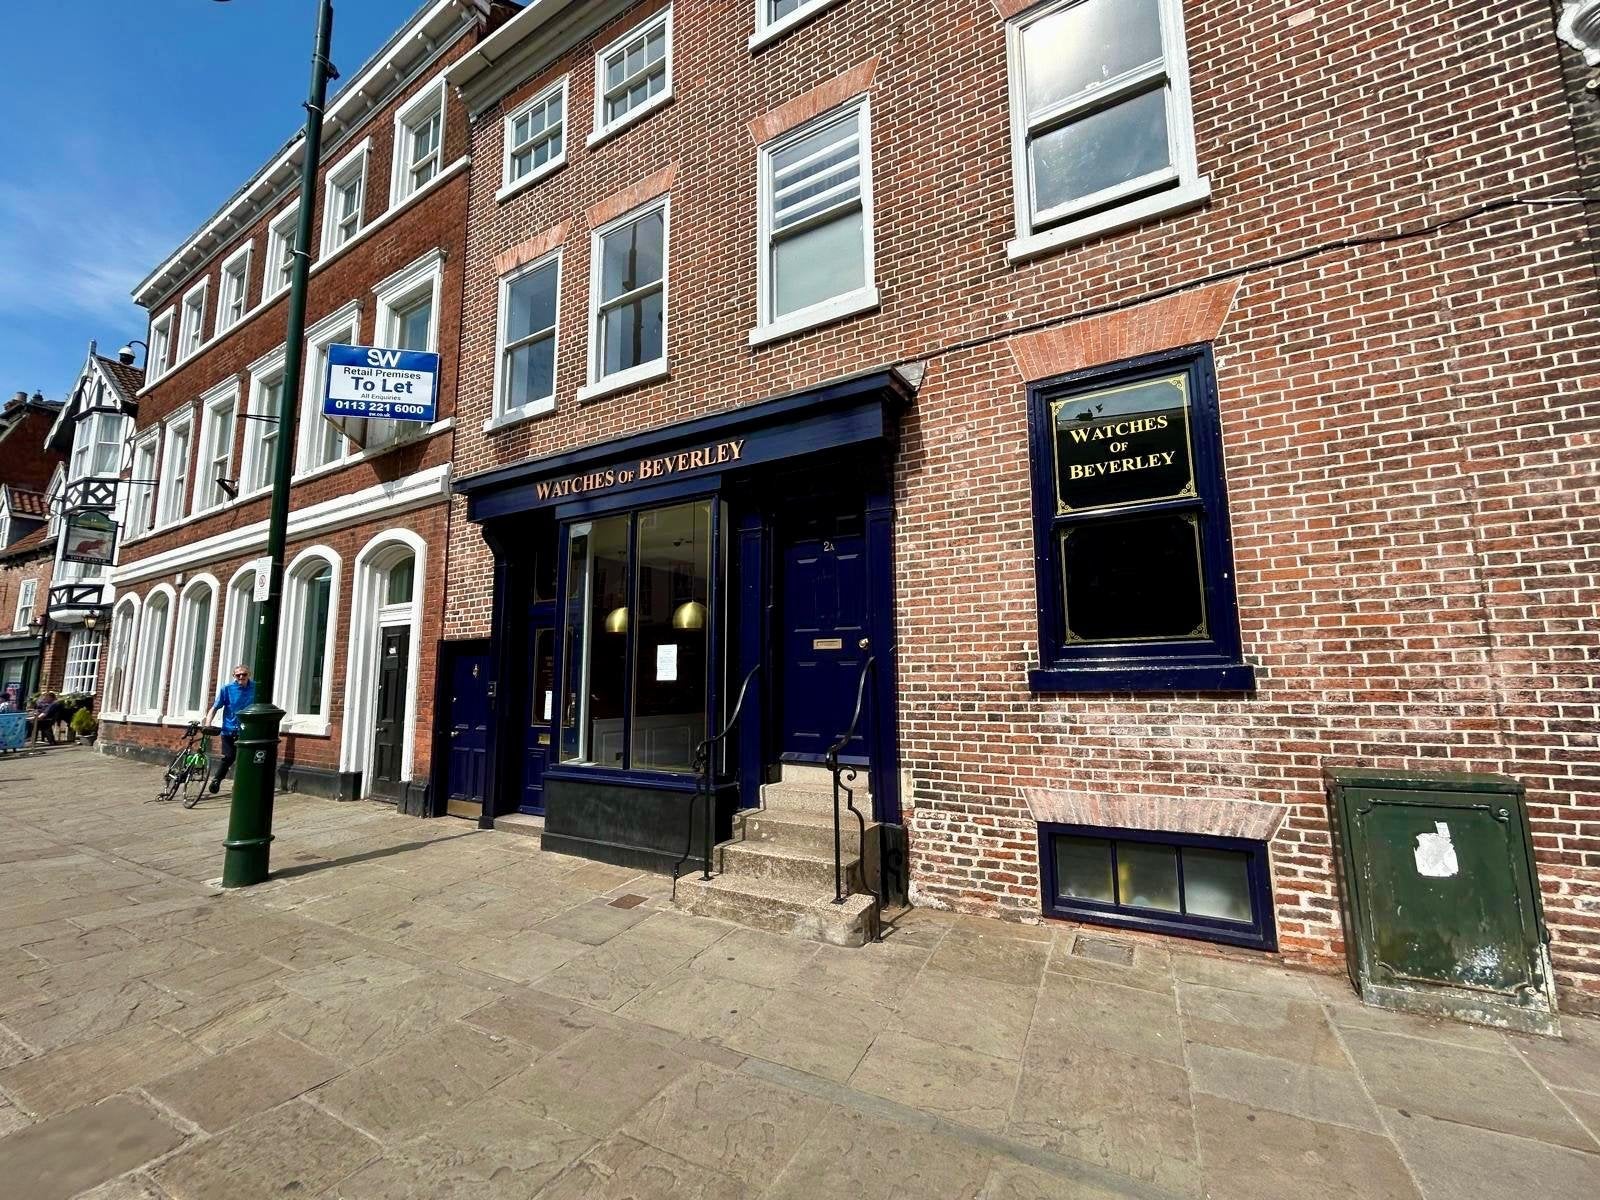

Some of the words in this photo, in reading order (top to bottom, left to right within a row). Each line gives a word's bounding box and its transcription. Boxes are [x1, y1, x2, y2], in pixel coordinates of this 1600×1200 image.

[367, 349, 401, 367] SW
[343, 366, 373, 377] Retail
[375, 369, 421, 380] Premises
[350, 376, 375, 392] To
[381, 378, 413, 394] Let
[371, 394, 402, 402] Enquiries
[335, 400, 366, 410] 0113
[368, 402, 390, 412] 221
[394, 404, 424, 415] 6000
[1070, 415, 1168, 444] WATCHES
[1109, 441, 1129, 454] OF
[535, 469, 614, 501] WATCHES
[618, 470, 635, 484] OF
[639, 440, 744, 479] BEVERLEY
[1069, 451, 1175, 480] BEVERLEY
